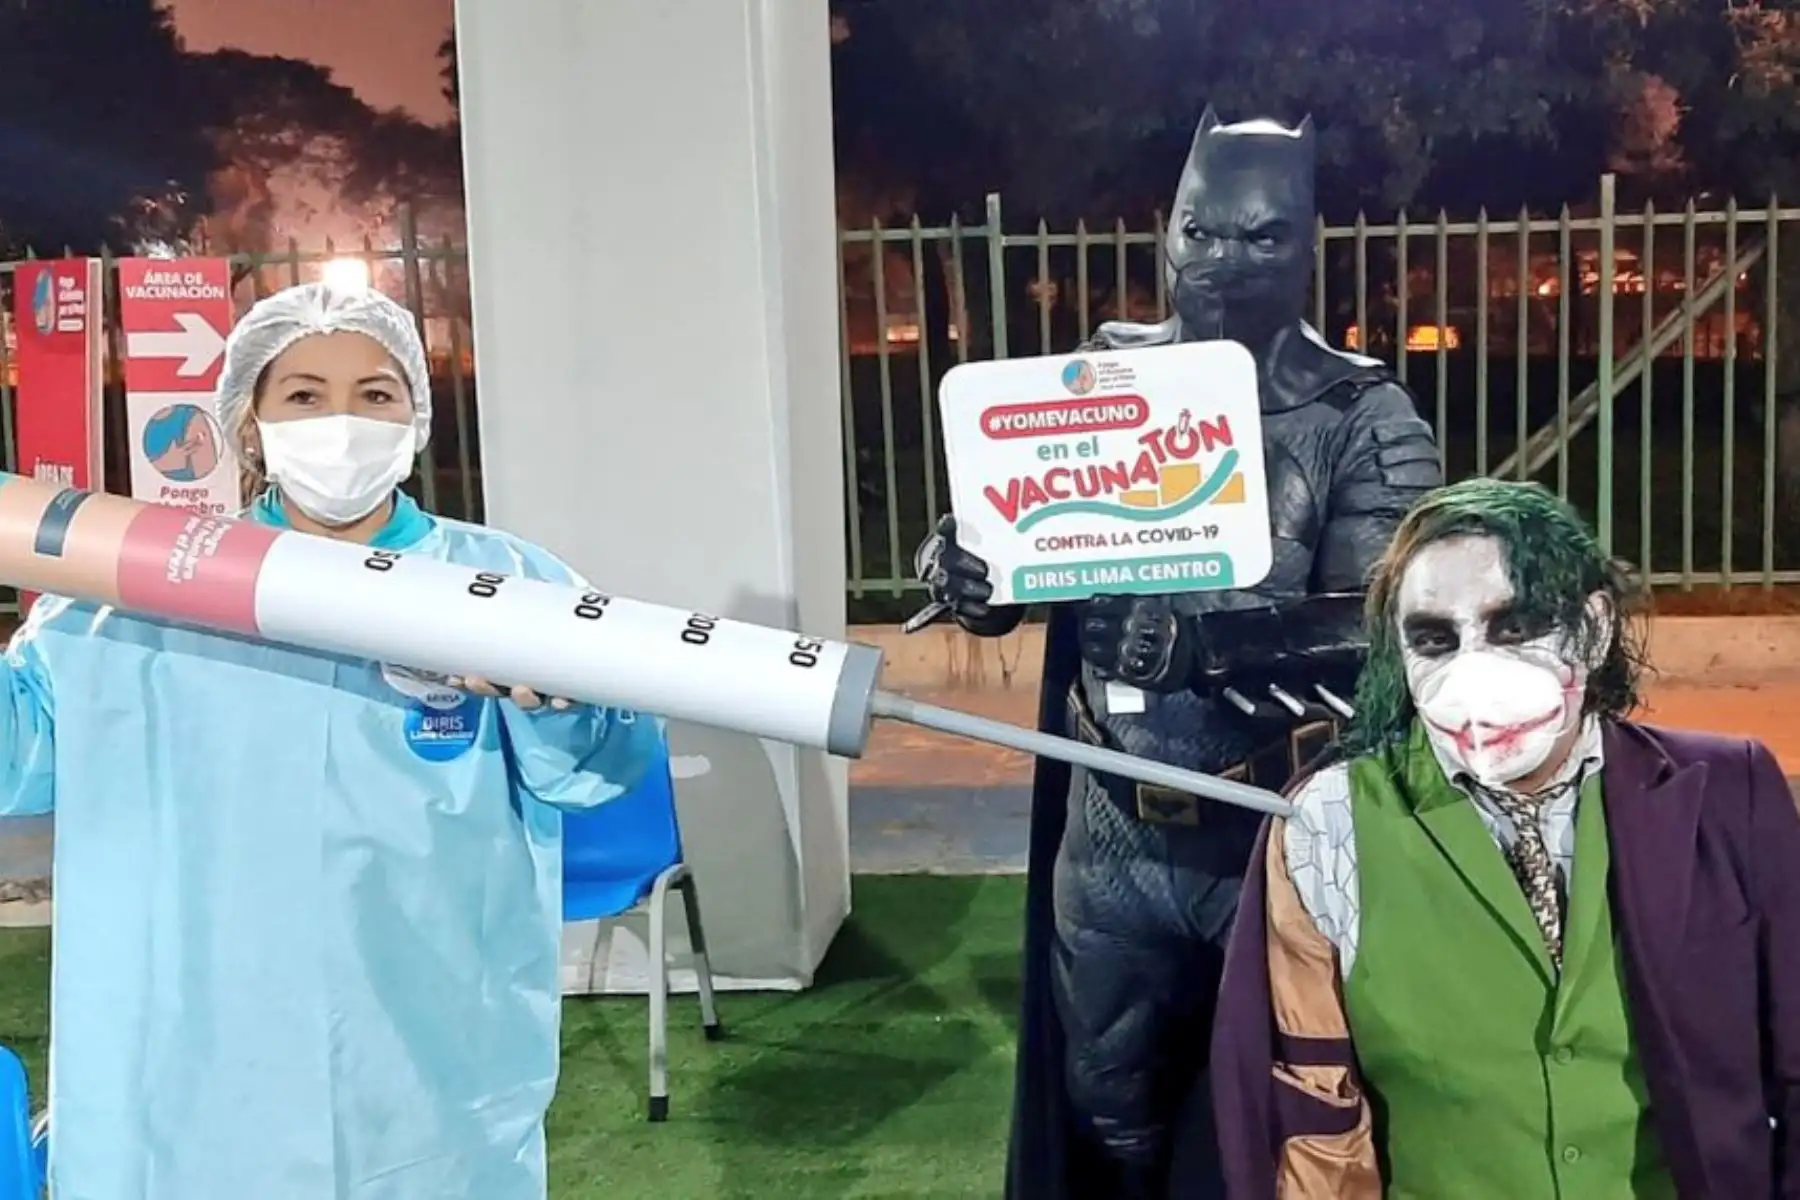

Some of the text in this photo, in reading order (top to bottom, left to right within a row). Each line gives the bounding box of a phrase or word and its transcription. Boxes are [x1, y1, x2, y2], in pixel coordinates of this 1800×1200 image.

[126, 283, 225, 299] VACUNACIÓN
[143, 269, 203, 285] ÁREA DE
[988, 403, 1139, 432] #YOMEVACUNO
[1037, 435, 1100, 461] en el
[983, 409, 1234, 523] VACUNATÓN
[160, 485, 209, 503] Pongo
[1034, 524, 1219, 552] CONTRA LA COVID-19
[467, 571, 508, 599] 00
[1023, 559, 1221, 590] DIRIS LIMA CENTRO
[789, 634, 822, 668] 50
